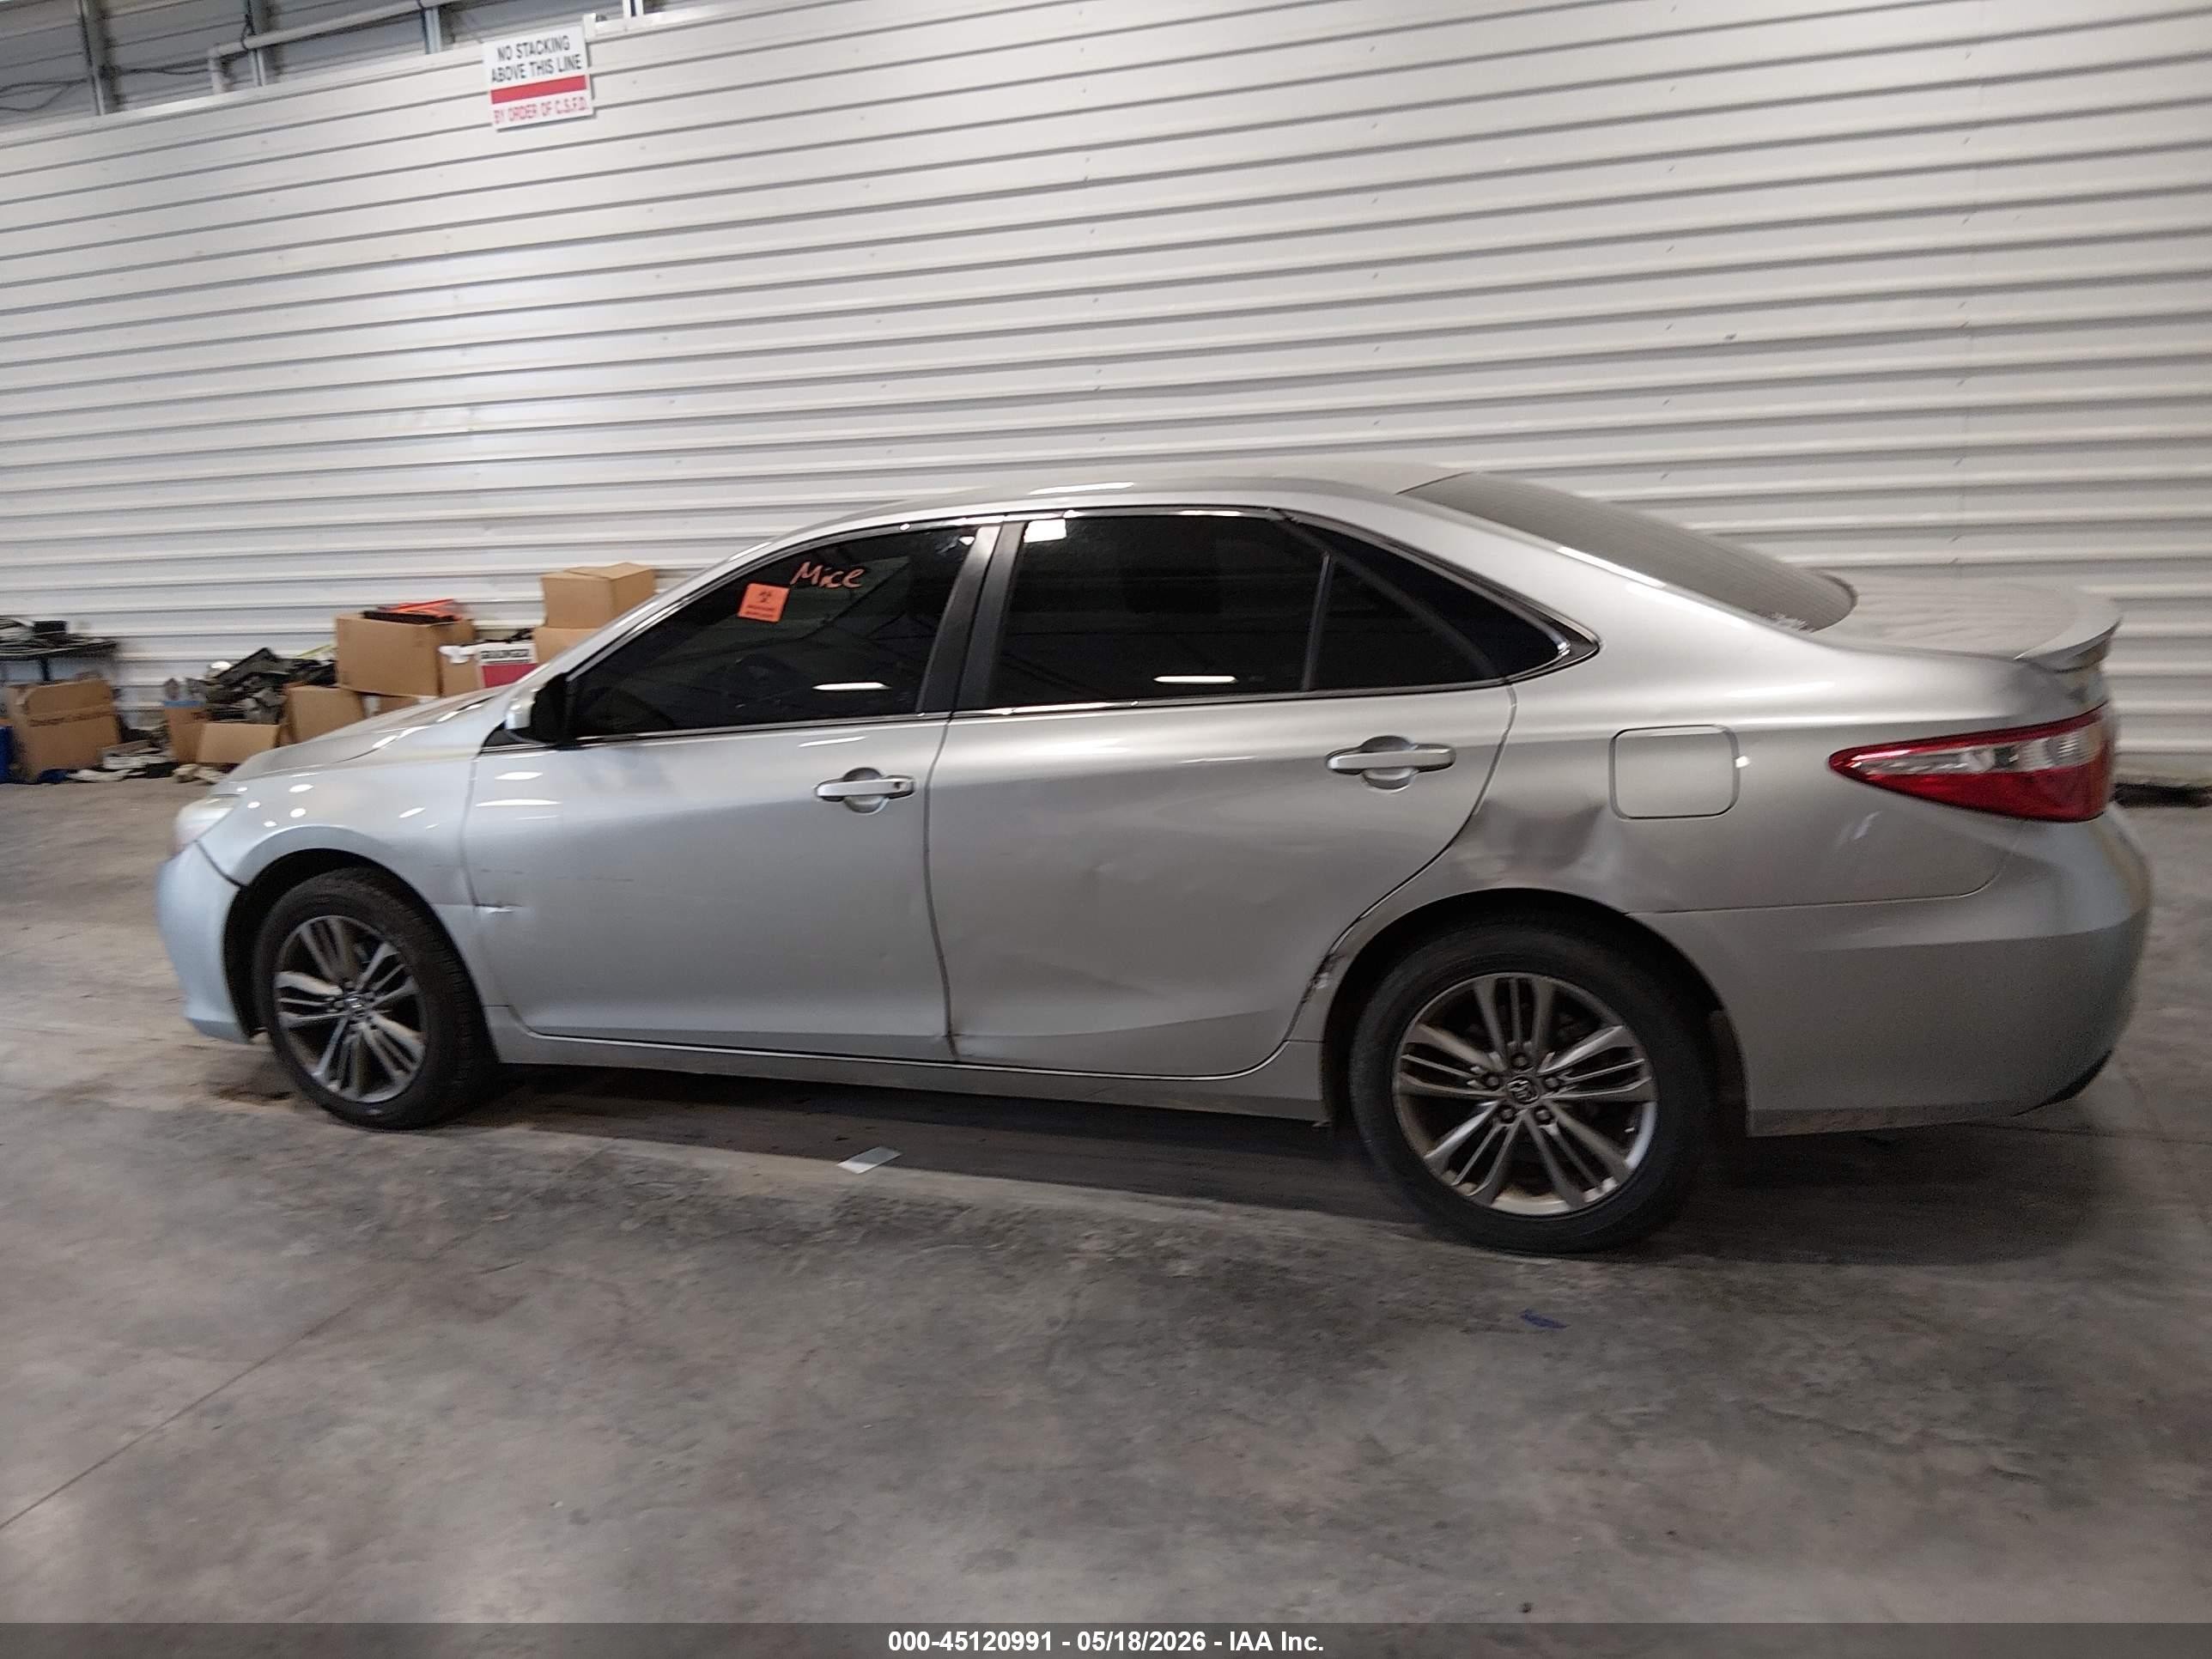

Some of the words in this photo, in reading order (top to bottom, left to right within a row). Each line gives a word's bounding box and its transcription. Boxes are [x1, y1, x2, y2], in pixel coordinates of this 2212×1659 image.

[497, 46, 513, 61] NO
[516, 35, 570, 58] STACKING
[492, 64, 526, 82] ABOVE
[530, 59, 555, 76] THIS
[557, 53, 582, 72] LINE
[494, 109, 505, 124] BY
[508, 104, 537, 121] ORDER
[541, 101, 551, 116] OF
